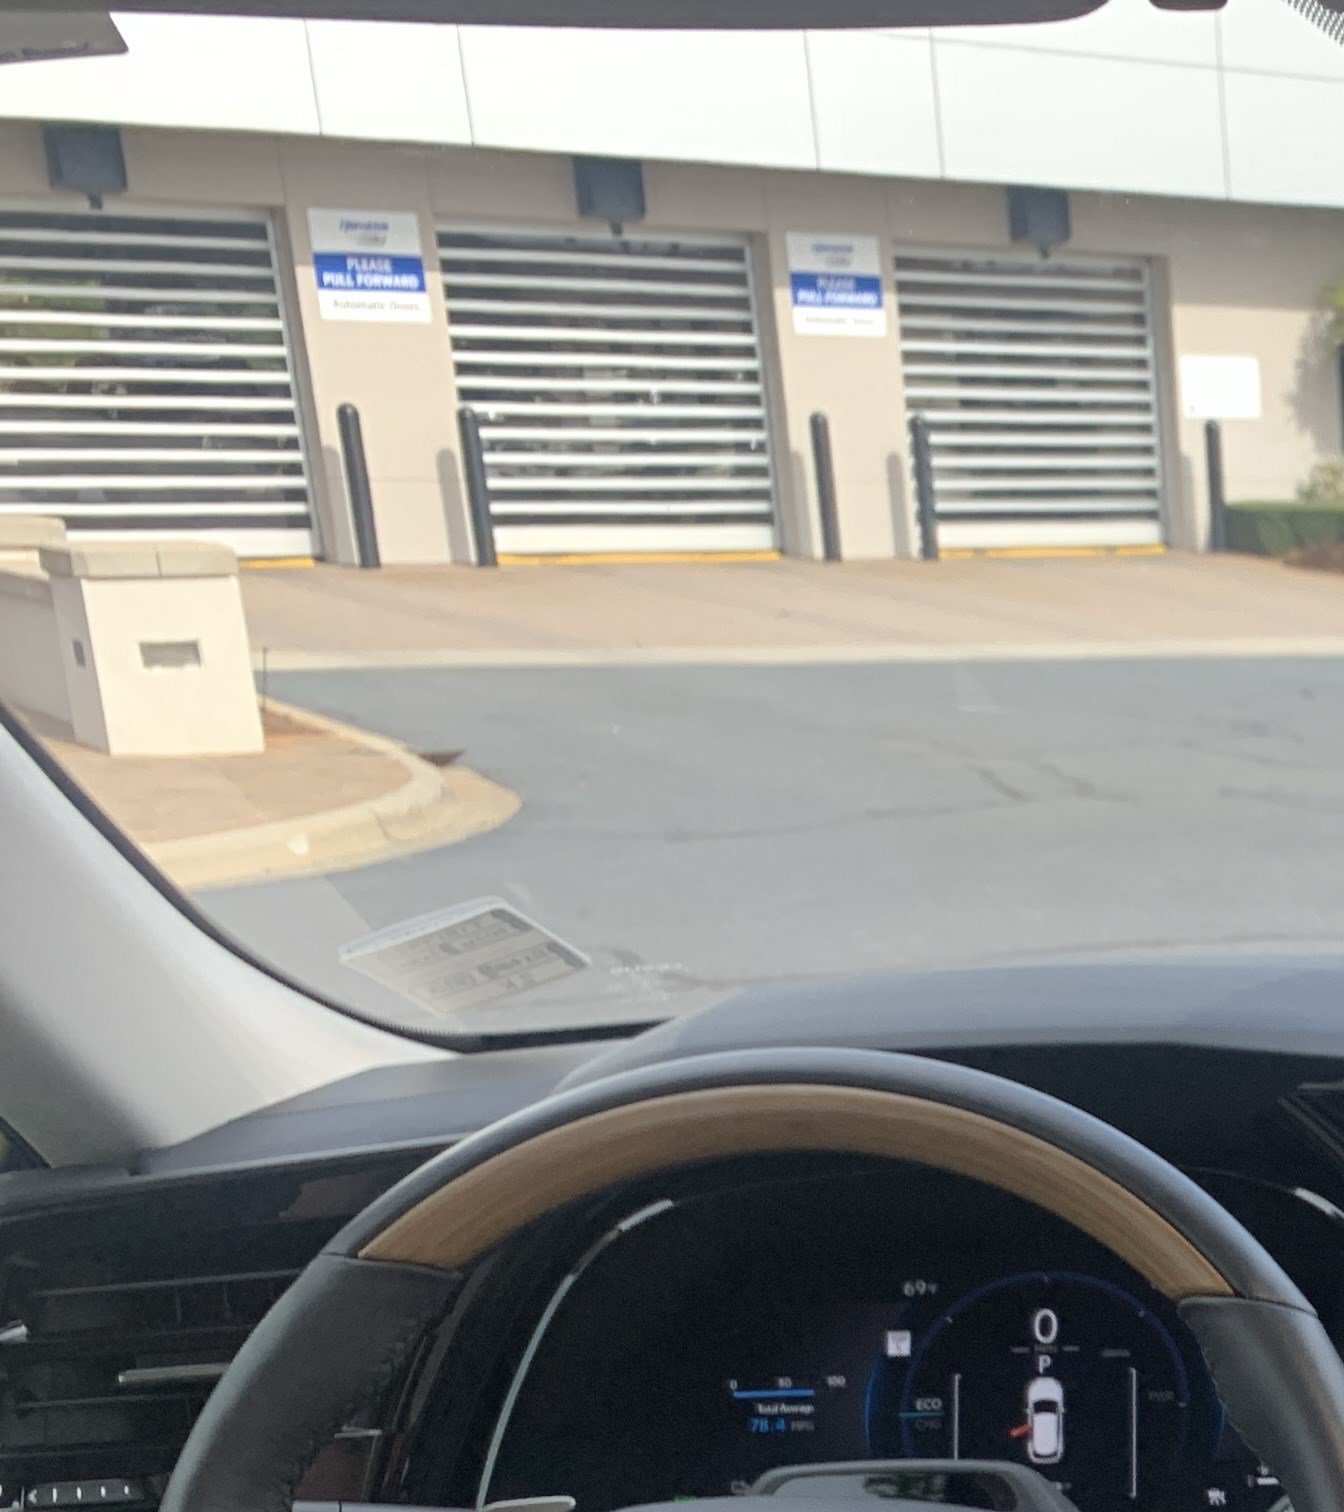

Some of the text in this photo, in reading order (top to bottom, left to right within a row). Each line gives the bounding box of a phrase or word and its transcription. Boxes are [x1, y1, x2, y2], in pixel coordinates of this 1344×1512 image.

[346, 257, 392, 273] PLEASE
[322, 271, 419, 289] PULL FORWARD
[1039, 1354, 1053, 1374] P
